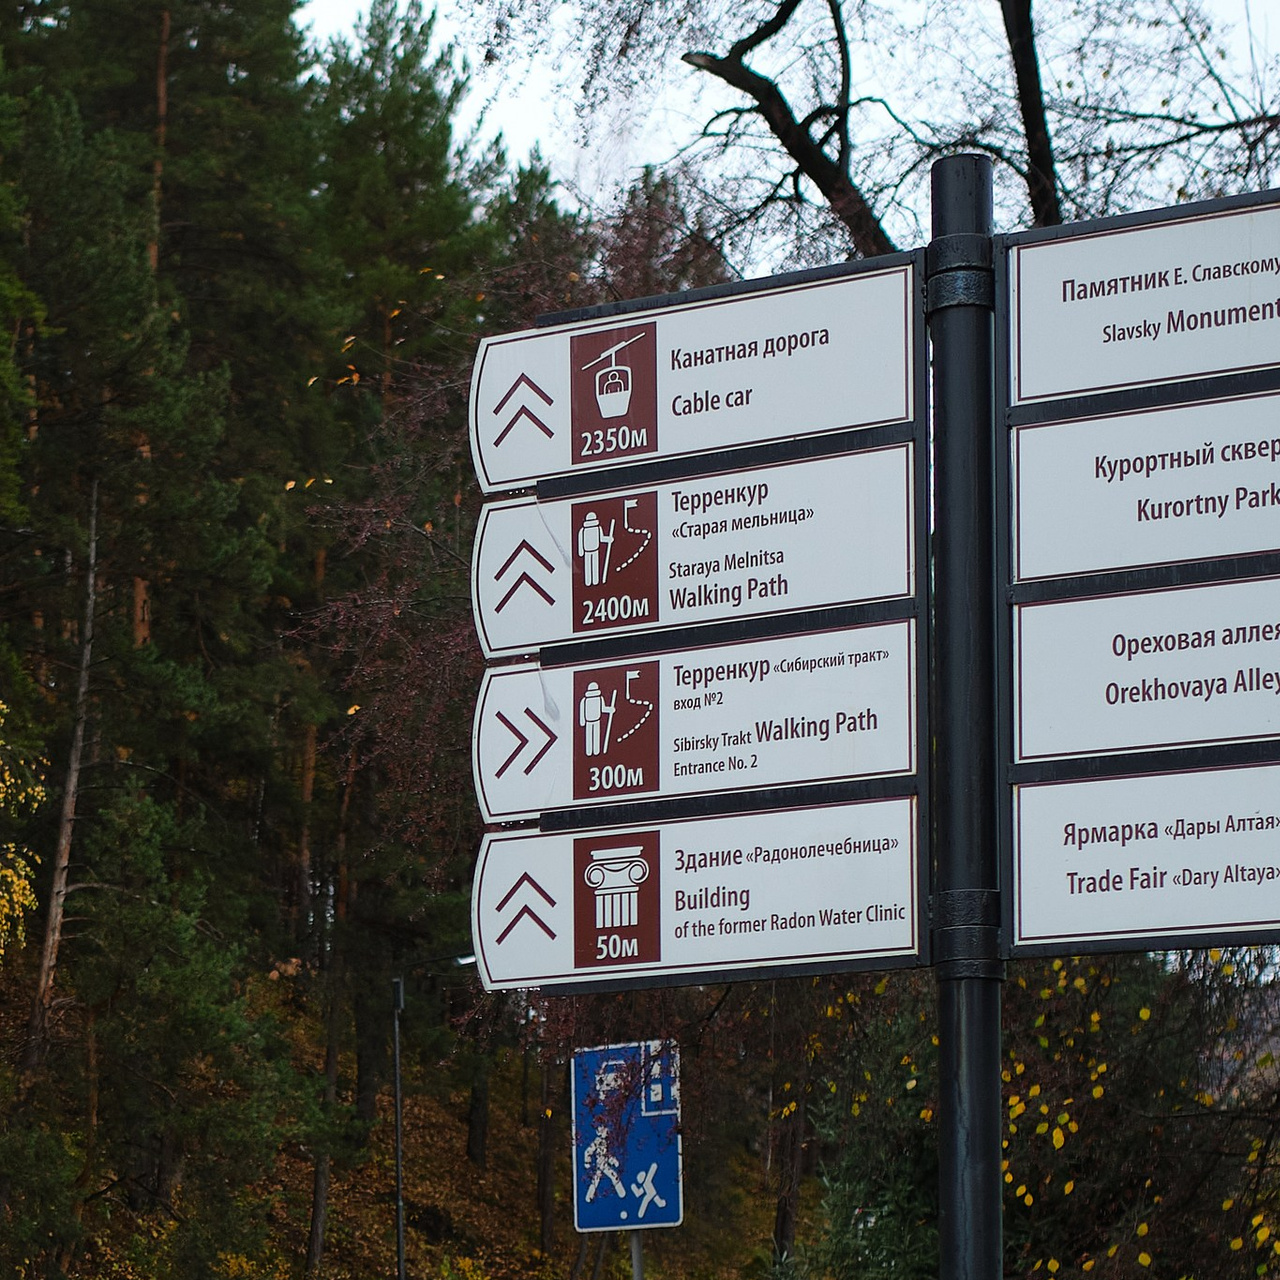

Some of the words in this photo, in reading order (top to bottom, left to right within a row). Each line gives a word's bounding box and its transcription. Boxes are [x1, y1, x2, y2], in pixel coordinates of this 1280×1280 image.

[1062, 270, 1170, 302] Памятник
[1174, 267, 1188, 285] Е.
[1103, 320, 1161, 343] Slavsky
[1167, 297, 1280, 334] Monument
[671, 340, 758, 371] Канатная
[762, 326, 830, 358] дорога
[671, 390, 720, 416] Cable
[725, 385, 753, 408] car
[1095, 442, 1215, 483] Курортный
[1221, 436, 1280, 462] сквер
[671, 481, 769, 514] Терренкур
[1136, 492, 1230, 522] Kurortny
[1235, 482, 1280, 510] Park
[671, 519, 728, 540] «Старая
[731, 507, 814, 532] мельница»
[668, 557, 720, 579] Staraya
[724, 549, 784, 571] Melnitsa
[669, 578, 742, 610] Walking
[747, 573, 788, 599] Path
[1112, 629, 1216, 661] Ореховая
[674, 657, 770, 688] Терренкур
[773, 652, 845, 674] «Сибирский
[848, 648, 889, 667] тракт»
[673, 695, 701, 711] вход
[1105, 676, 1228, 705] Orekhovaya
[673, 733, 719, 753] Sibirsky
[721, 730, 752, 747] Trakt
[755, 715, 830, 744] Walking
[835, 709, 878, 733] Path
[673, 758, 725, 777] Entrance
[728, 756, 748, 771] No.
[751, 754, 758, 769] 2
[1063, 819, 1159, 851] Ярмарка
[1164, 818, 1221, 840] «Дары
[674, 847, 743, 874] Здание
[746, 837, 899, 866] «Радонолечебница»
[1066, 869, 1124, 894] Trade
[1129, 866, 1168, 891] Fair
[1172, 868, 1220, 889] «Dary
[674, 886, 751, 913] Building
[674, 919, 689, 939] of
[691, 917, 716, 938] the
[718, 913, 767, 936] former
[770, 910, 815, 931] Radon
[819, 907, 862, 928] Water
[866, 902, 905, 924] Clinic
